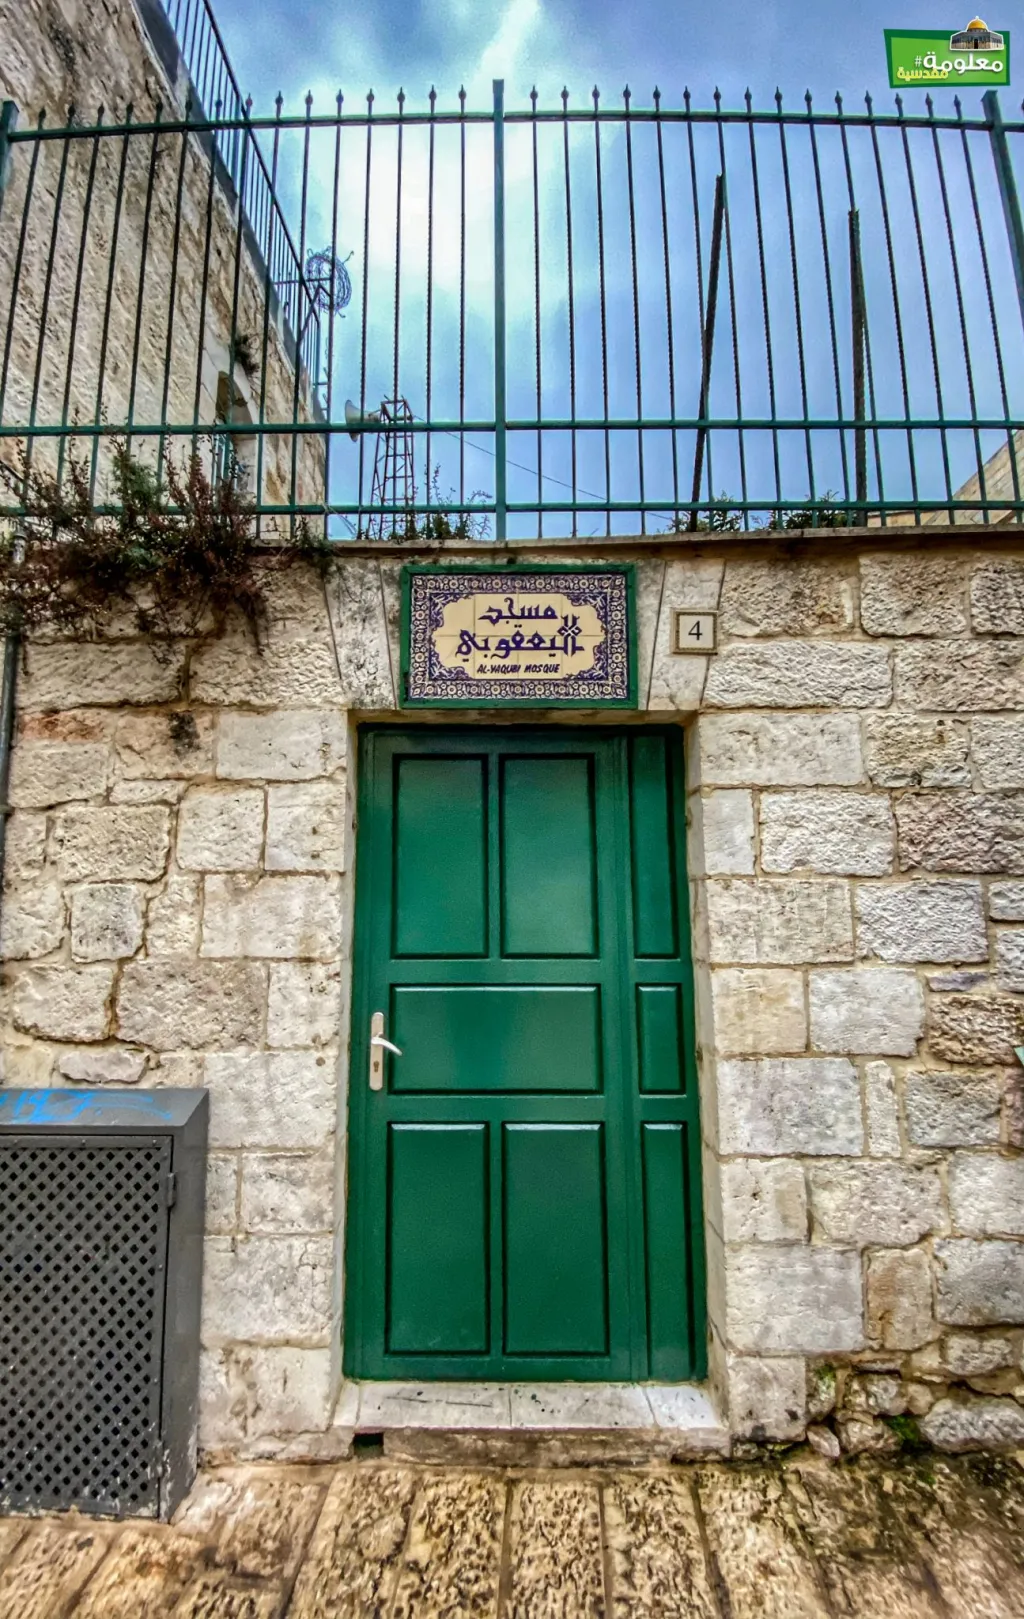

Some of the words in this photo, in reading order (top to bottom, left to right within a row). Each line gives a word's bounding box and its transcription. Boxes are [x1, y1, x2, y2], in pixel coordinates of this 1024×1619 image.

[477, 596, 558, 627] مسجد
[687, 620, 703, 641] 4
[523, 663, 561, 675] MOSQUE
